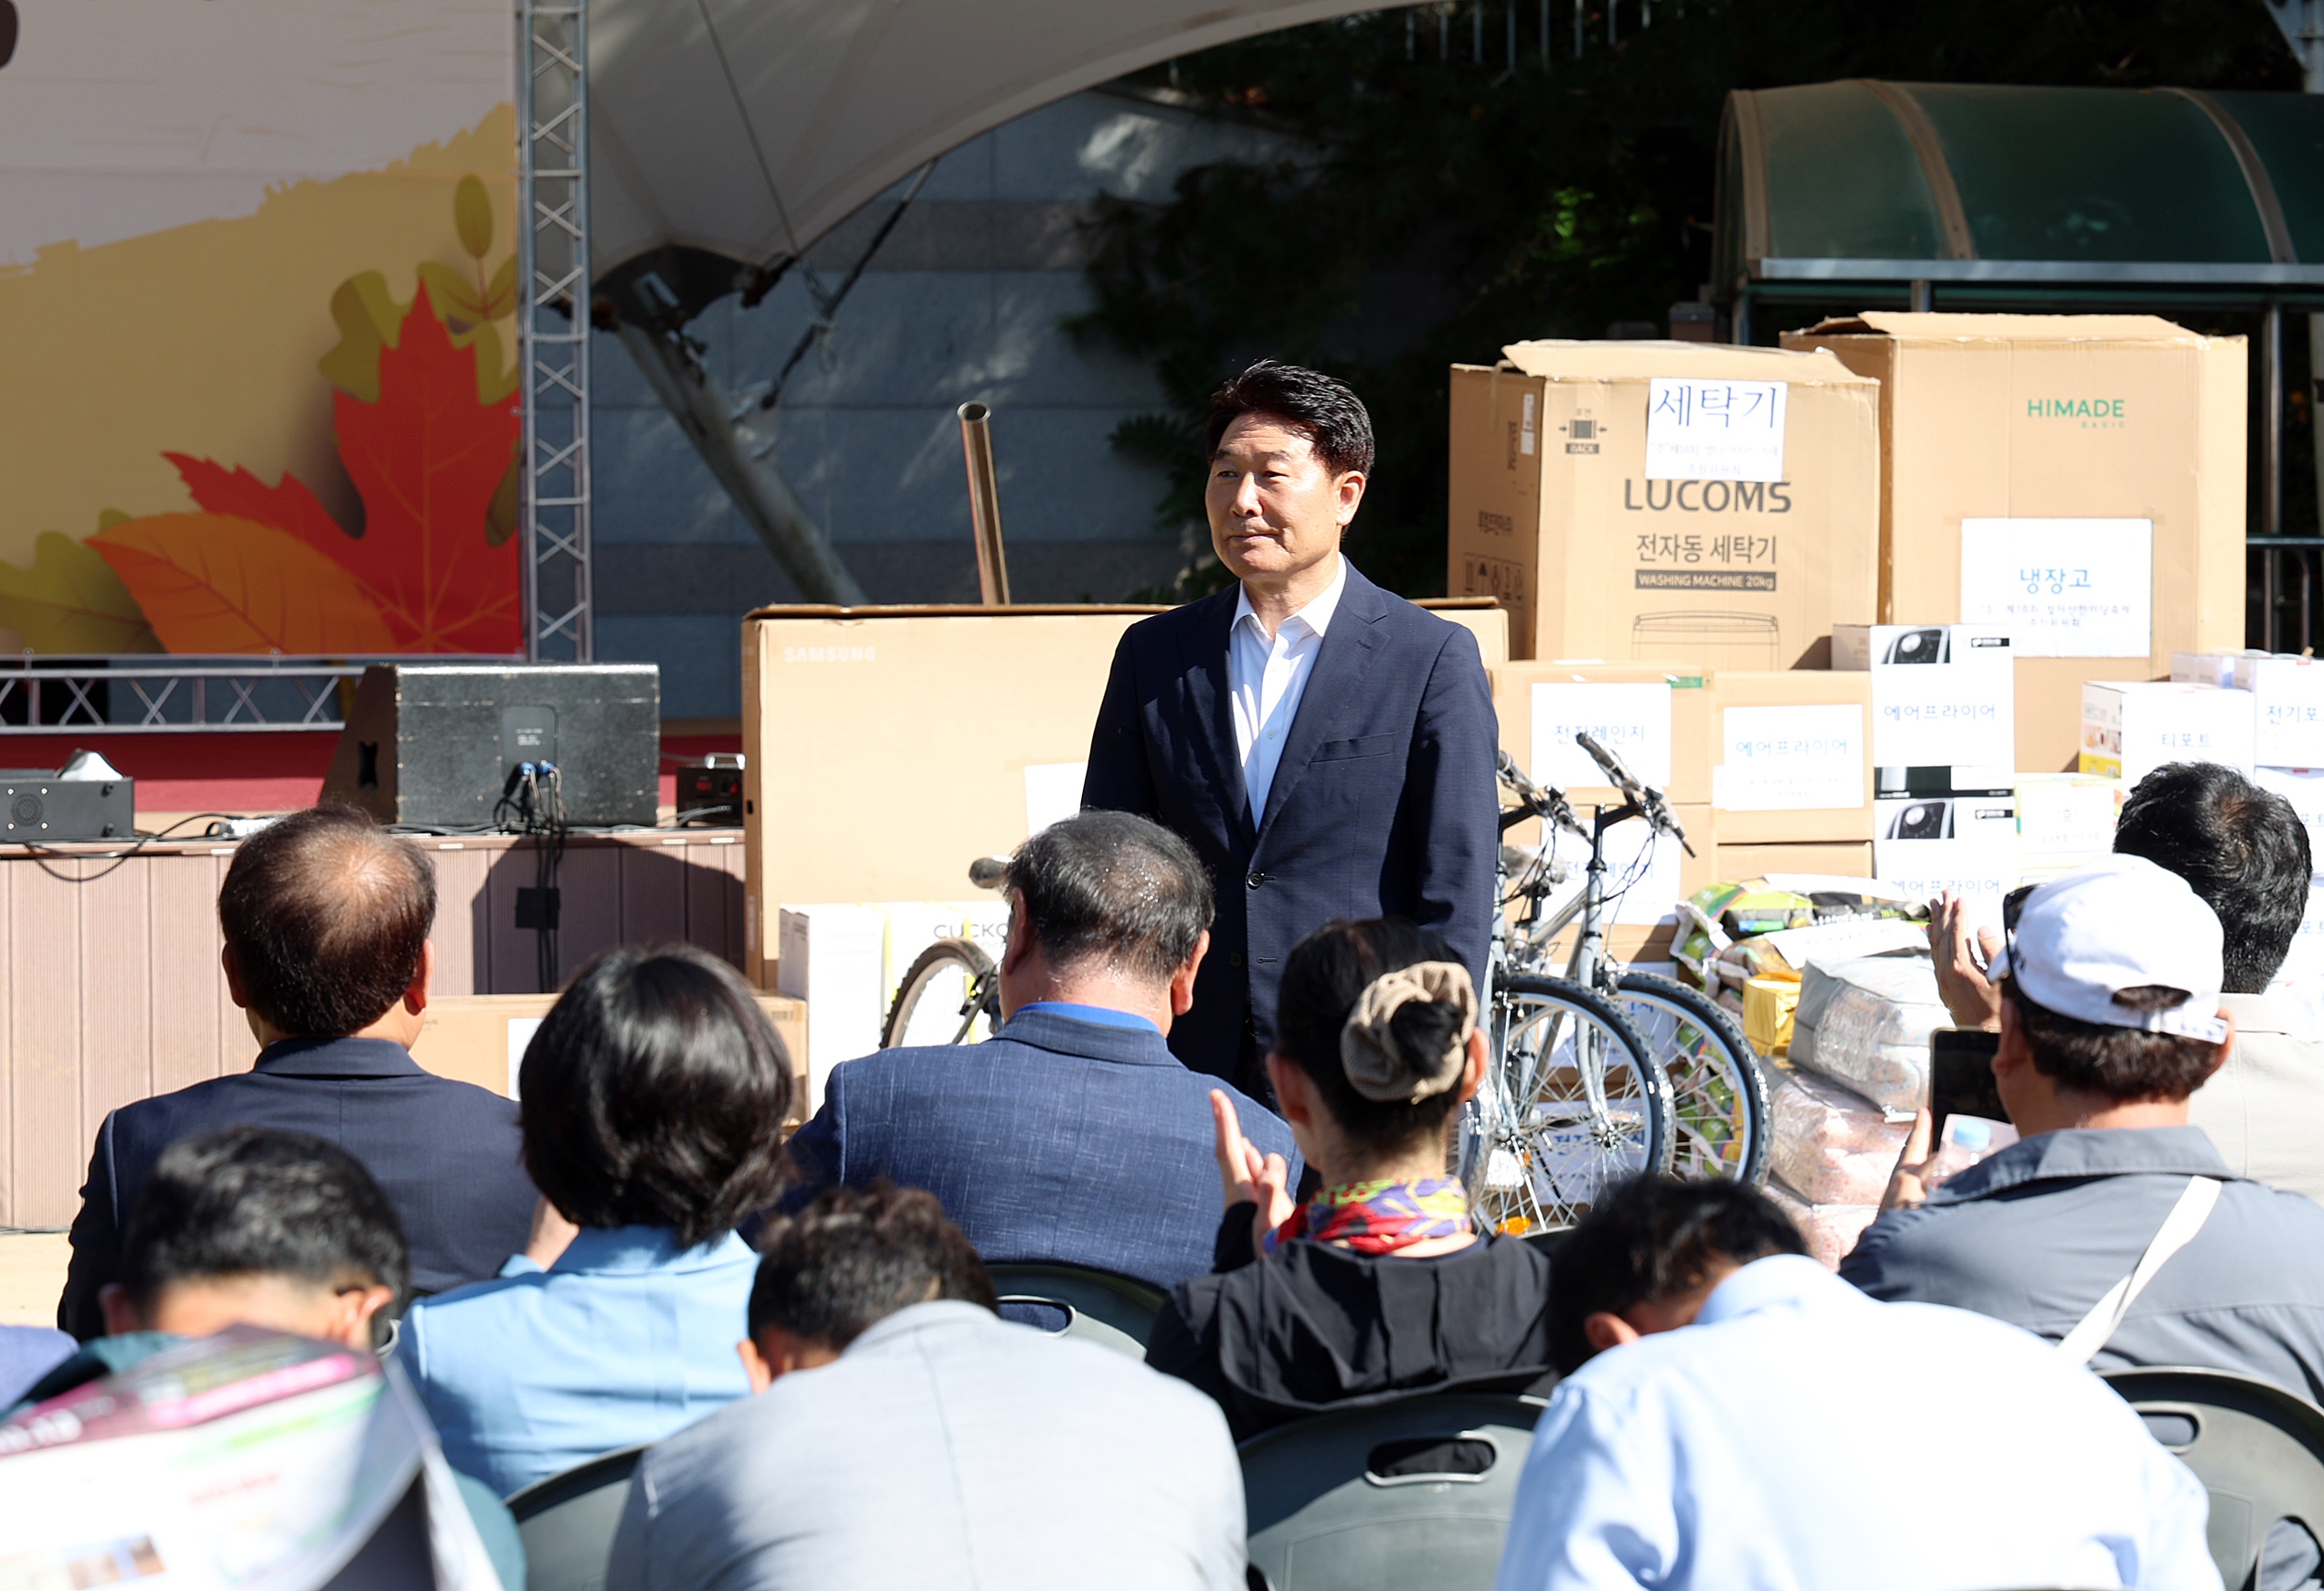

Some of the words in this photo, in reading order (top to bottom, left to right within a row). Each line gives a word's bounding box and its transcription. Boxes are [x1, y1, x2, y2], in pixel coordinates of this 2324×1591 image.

[1654, 385, 1777, 429] 세탁기
[2027, 399, 2126, 418] HIMADE
[1623, 479, 1792, 514] LUCOMS
[1636, 534, 1703, 563] 전자동
[1710, 534, 1777, 564] 세탁기
[1639, 573, 1692, 587] WASHING
[1693, 574, 1745, 588] MACHINE
[1746, 575, 1774, 590] 20kg
[2020, 567, 2092, 595] 냉장고
[784, 646, 876, 663] SAMSUNG
[1884, 704, 1996, 721] 에어프라이어
[2266, 705, 2324, 725] 전기포
[1735, 738, 1848, 758] 에어프라이어
[2162, 732, 2213, 748] 티포트
[933, 923, 1009, 939] CUCKO
